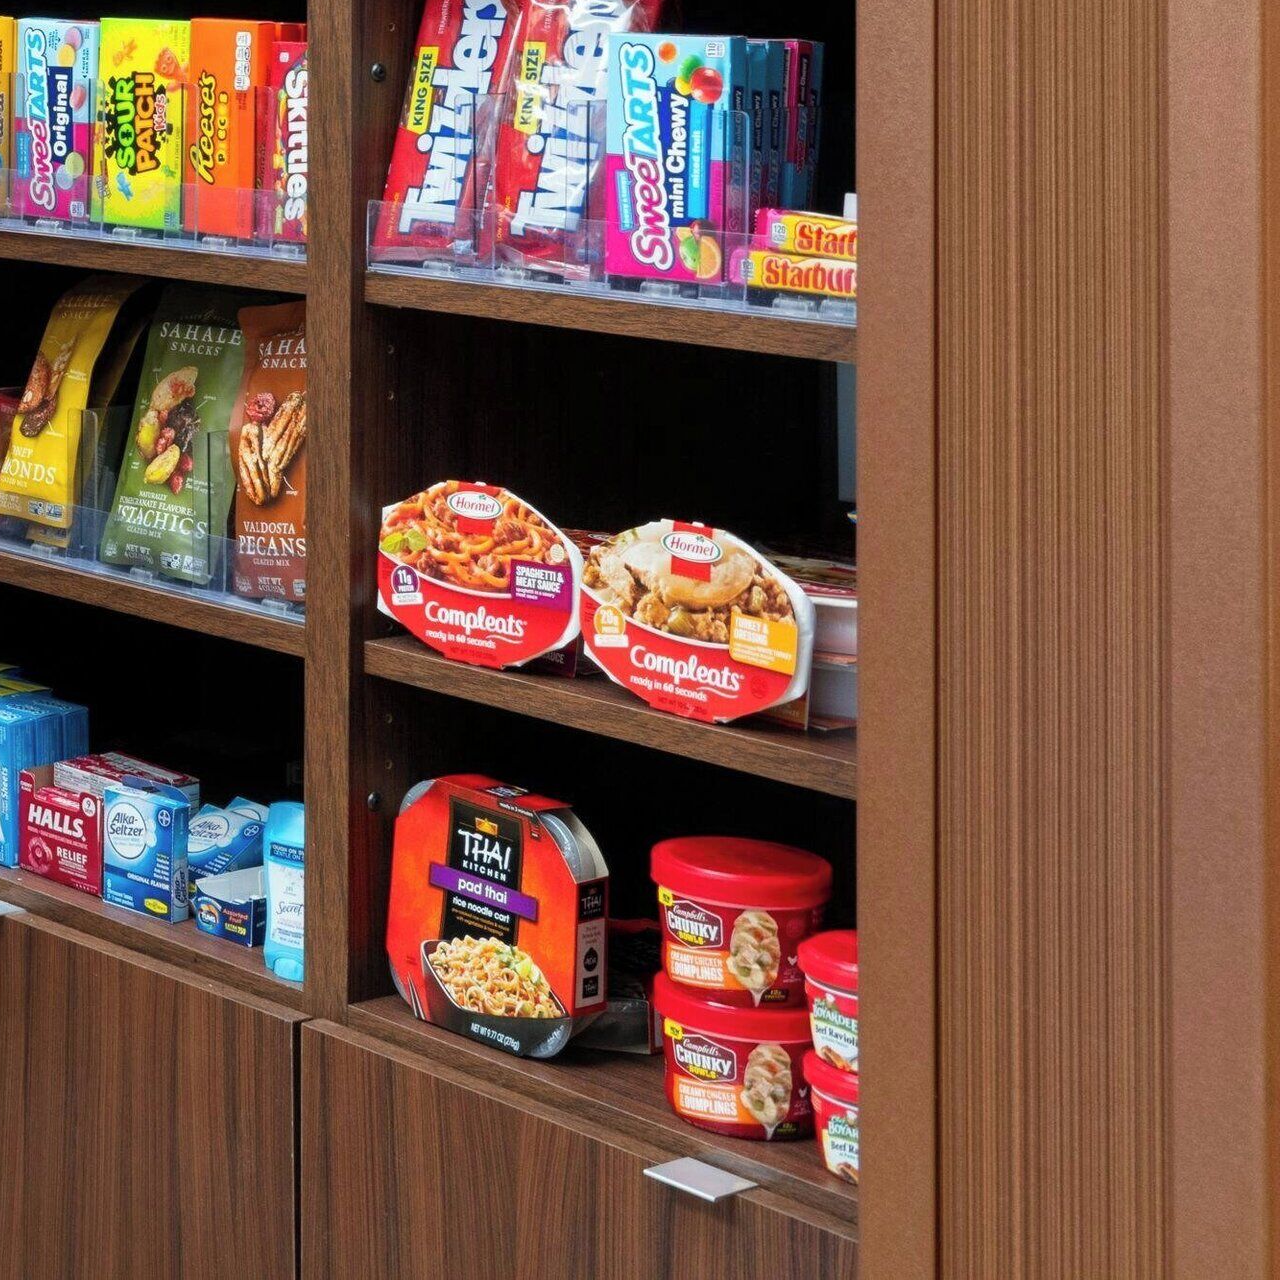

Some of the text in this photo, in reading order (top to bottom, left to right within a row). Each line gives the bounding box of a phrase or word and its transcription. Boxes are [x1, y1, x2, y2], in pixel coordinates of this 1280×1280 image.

[525, 48, 540, 81] SIZE
[413, 52, 433, 127] KING SIZE
[53, 74, 69, 158] Original
[114, 77, 135, 169] SOUR
[135, 71, 161, 174] PATCH
[666, 92, 689, 220] mini Chewy
[692, 128, 704, 189] mixed fruit
[160, 321, 243, 347] SAHALE
[170, 342, 222, 357] SNACKS
[454, 497, 496, 514] Hormel
[243, 520, 296, 535] VALDOSTA
[238, 534, 308, 558] PECANS
[670, 537, 715, 556] Hormel
[515, 566, 556, 582] SPAGHETTI
[515, 576, 537, 589] MEAT
[537, 579, 561, 594] SAUCE
[424, 600, 525, 638] Compleats
[425, 630, 497, 650] ready in 60 seconds
[630, 645, 741, 692] Compleats
[630, 675, 708, 702] ready in 60 seconds
[28, 803, 84, 839] HALLS
[111, 812, 138, 826] Alka-
[195, 819, 223, 831] Alka-
[109, 823, 144, 838] Seltzer
[56, 846, 88, 865] RELIEF
[458, 829, 511, 870] THAI
[127, 872, 151, 886] ORIGINAL
[462, 859, 507, 882] KITCHEN
[457, 876, 508, 905] pad thai
[276, 901, 303, 915] Secret
[452, 896, 467, 909] rice
[467, 900, 493, 919] noodle
[493, 909, 510, 923] cart
[673, 904, 709, 923] Campbell's
[668, 912, 718, 942] CHUNKY
[694, 954, 723, 968] CHICKEN
[677, 963, 723, 982] DUMPLINGS
[682, 1038, 721, 1057] Campbell's
[676, 1046, 732, 1076] CHUNKY
[706, 1087, 737, 1101] CHICKEN
[686, 1097, 737, 1117] DUMPLINGS
